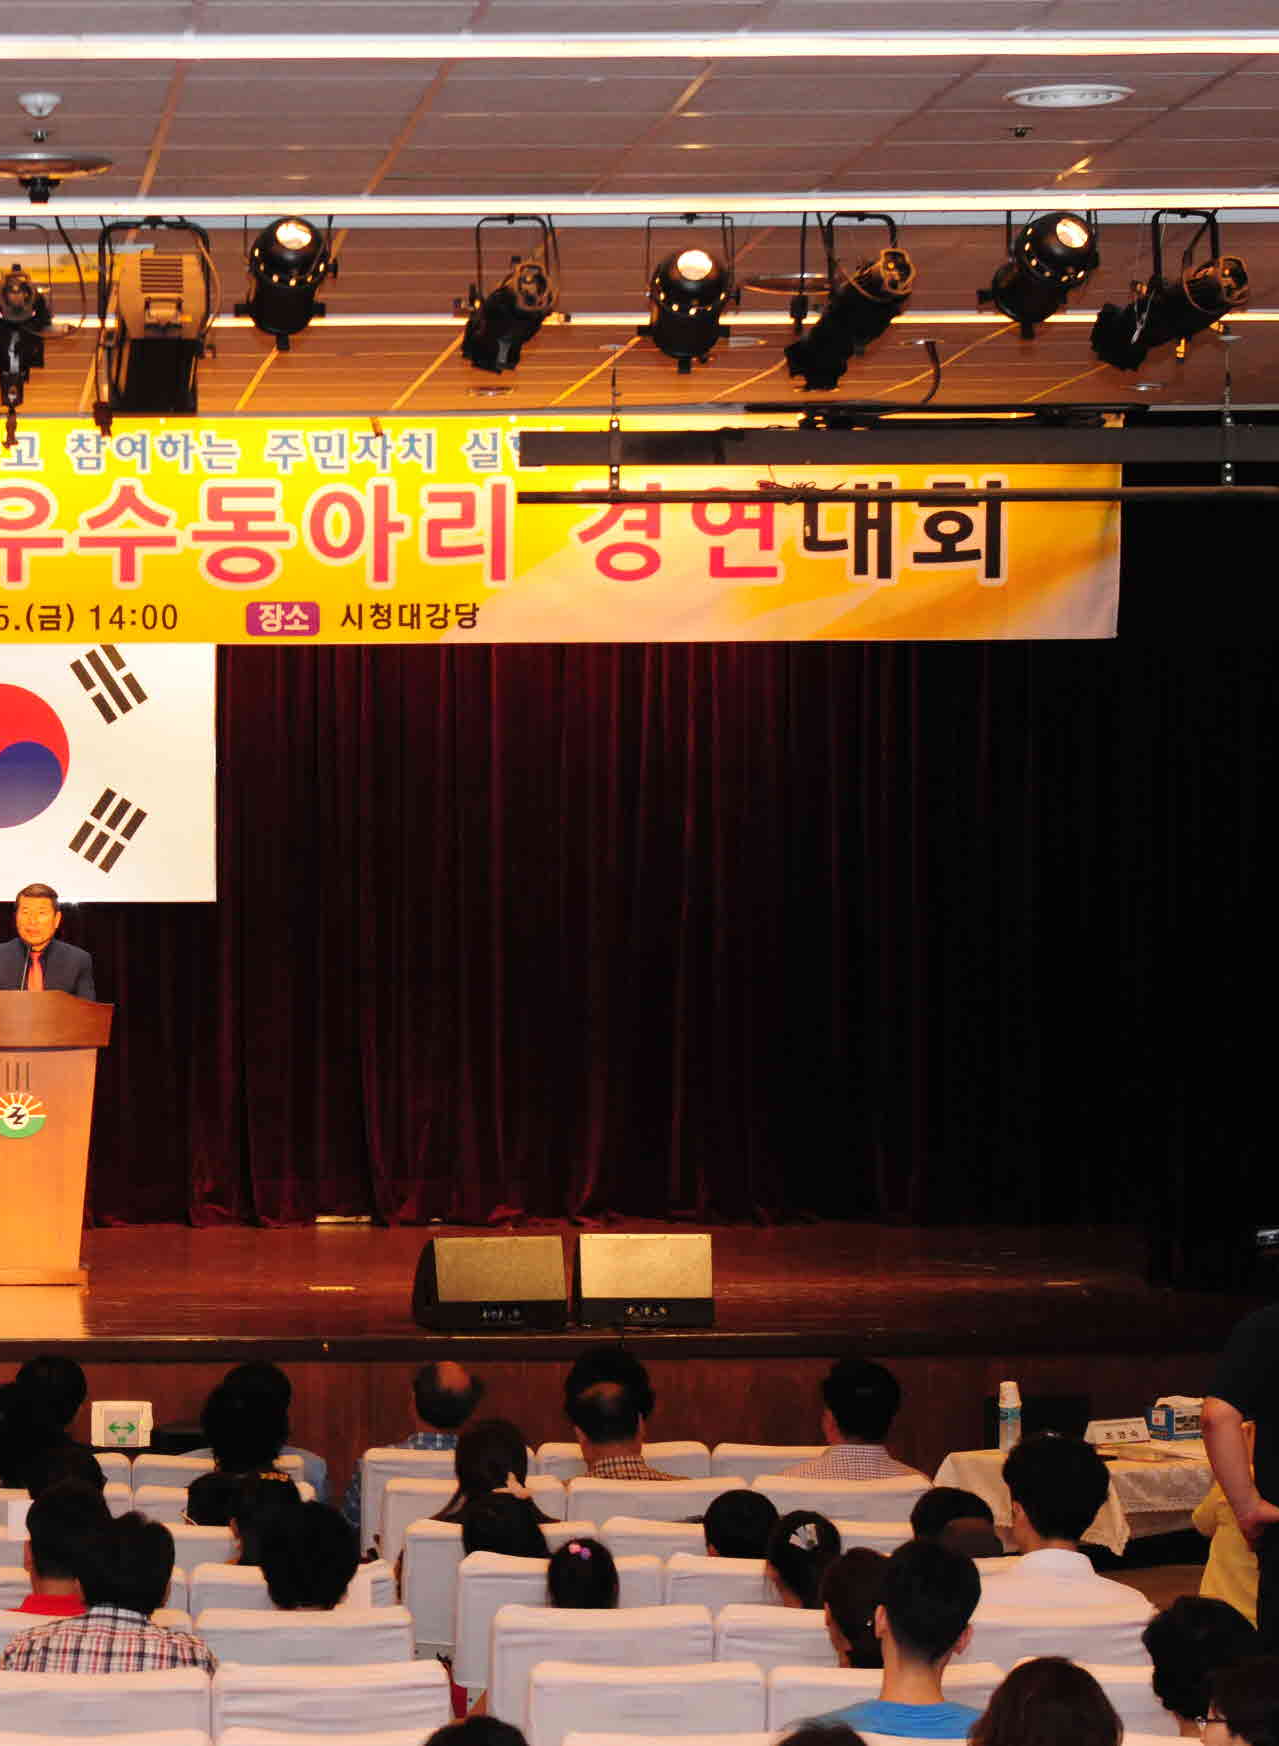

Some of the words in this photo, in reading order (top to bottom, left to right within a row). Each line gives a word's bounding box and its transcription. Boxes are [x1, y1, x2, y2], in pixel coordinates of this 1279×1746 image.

[70, 432, 237, 471] 참여하는
[267, 432, 433, 470] 주민자치
[89, 603, 179, 631] 14:00
[258, 603, 311, 633] 장소
[340, 603, 481, 630] 시청대강당
